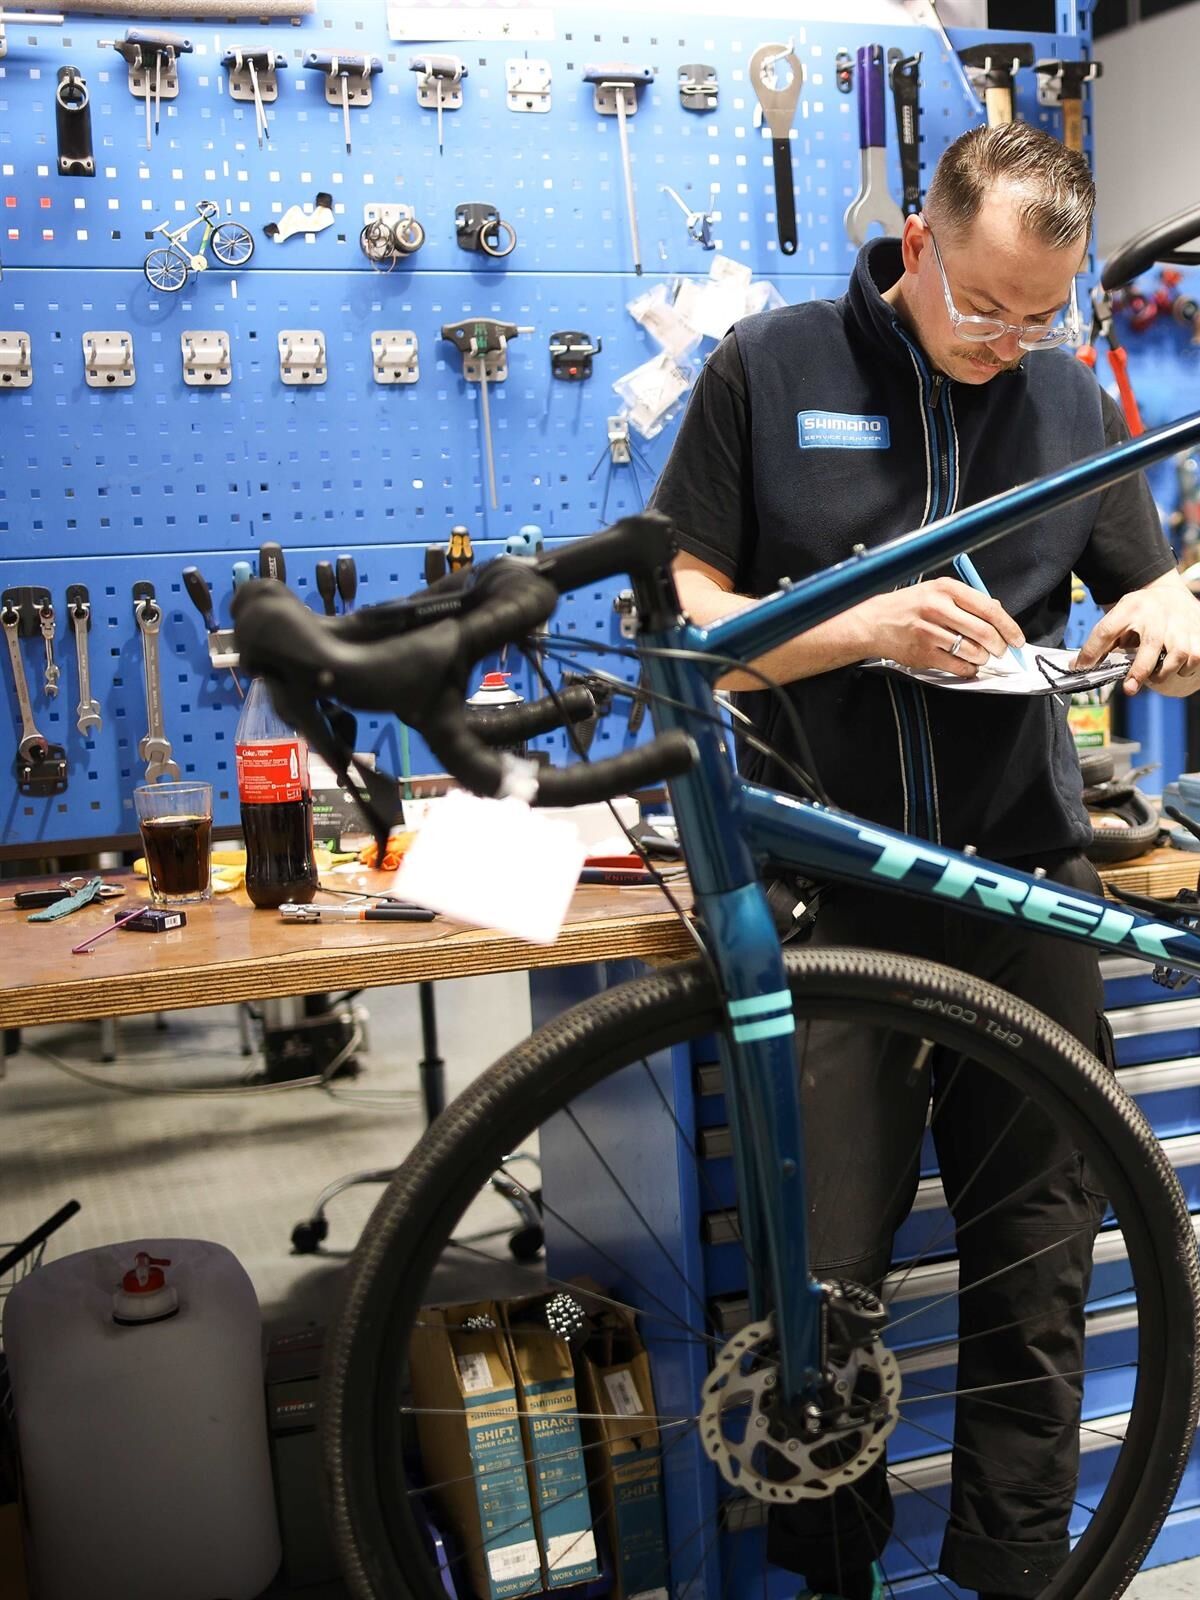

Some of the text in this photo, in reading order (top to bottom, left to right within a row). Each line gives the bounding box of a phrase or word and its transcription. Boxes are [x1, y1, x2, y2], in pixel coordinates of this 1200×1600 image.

[804, 417, 881, 432] SHIMANO
[858, 830, 1187, 959] TREK
[911, 998, 977, 1025] COMP
[533, 1416, 575, 1432] BRAKE
[476, 1426, 514, 1442] SHIFT
